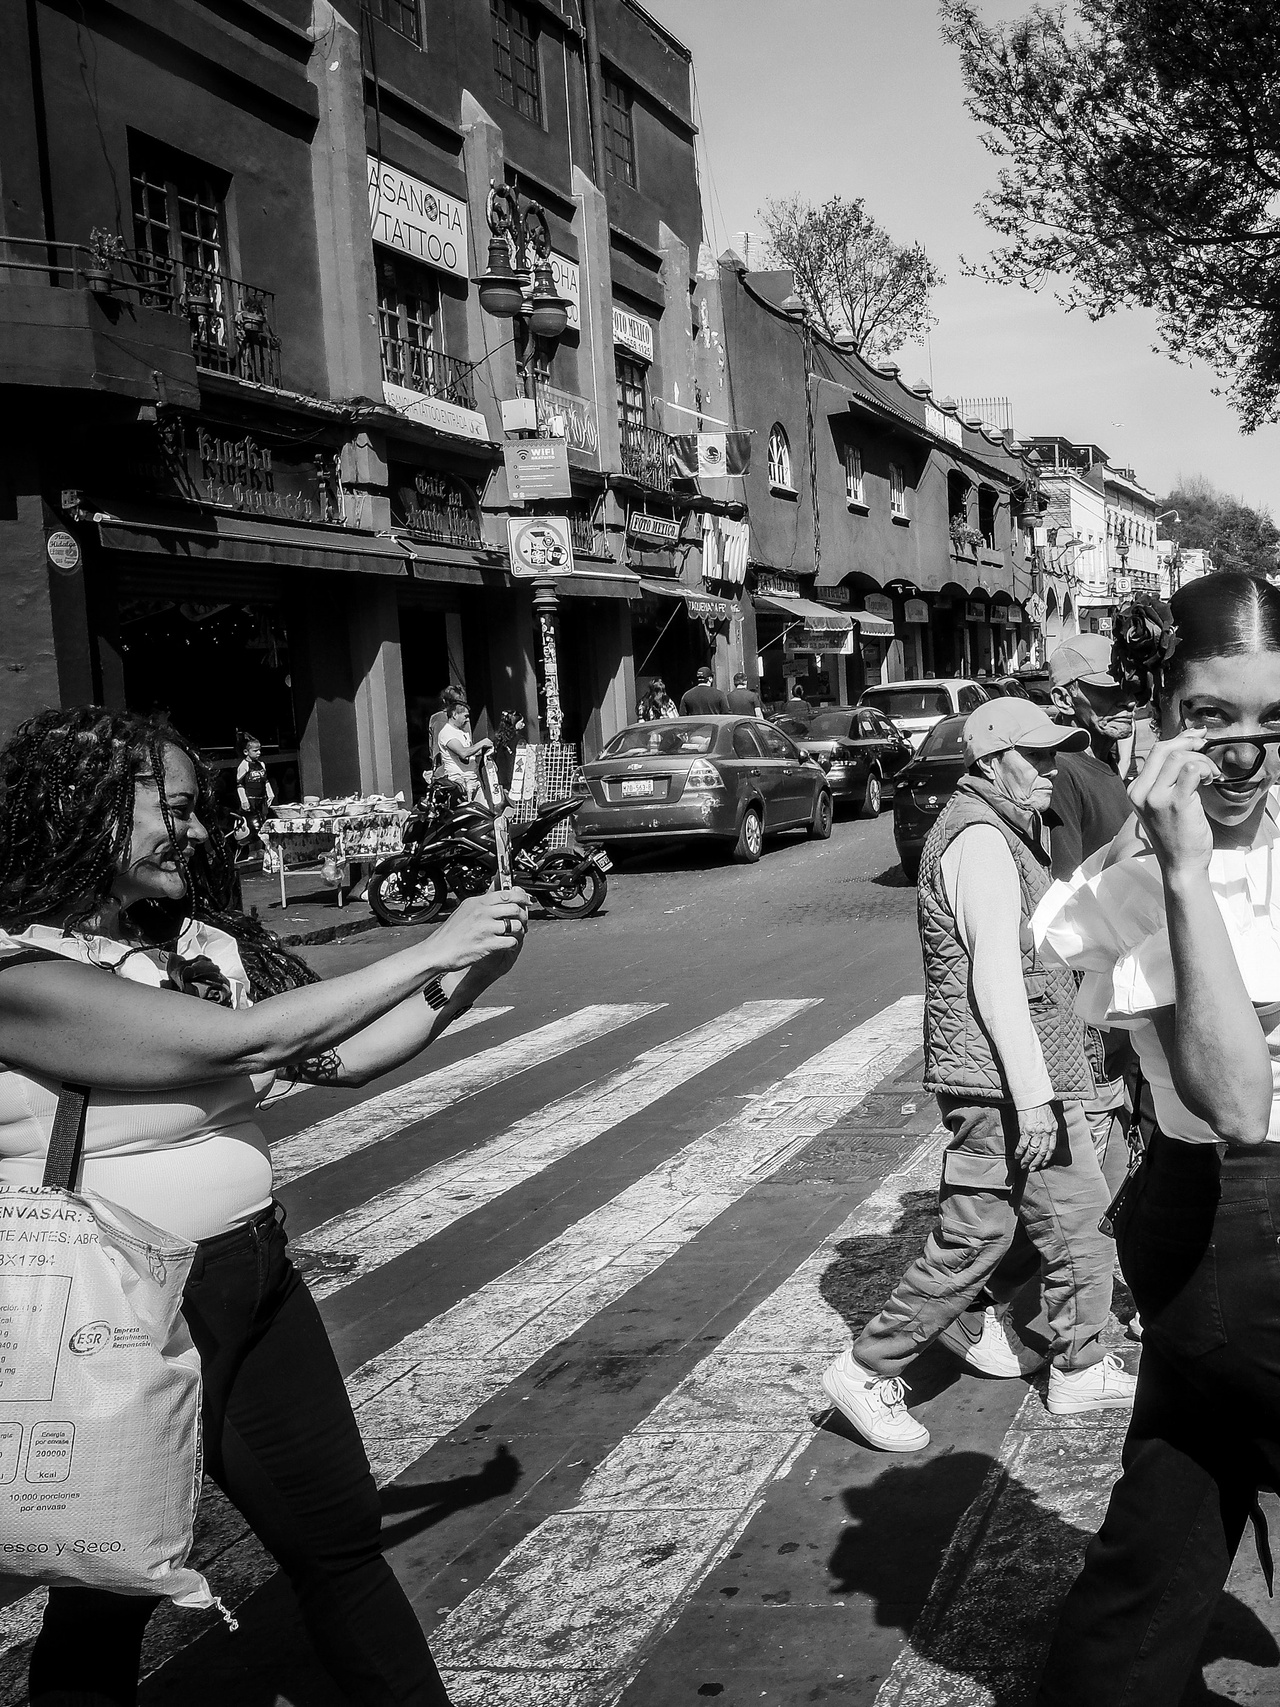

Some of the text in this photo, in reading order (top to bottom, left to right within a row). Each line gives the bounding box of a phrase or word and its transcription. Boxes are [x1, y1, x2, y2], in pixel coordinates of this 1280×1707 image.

[378, 210, 458, 270] TATTOO
[613, 310, 627, 335] OTO
[634, 516, 676, 538] FOTO MEXICO
[0, 1206, 83, 1223] NVASAR:
[18, 1230, 71, 1244] ANTES:
[113, 1327, 140, 1335] Empresa
[76, 1333, 102, 1345] ESR
[35, 1450, 67, 1458] 200000
[40, 1492, 81, 1501] porciones
[20, 1503, 67, 1513] por envase
[0, 1540, 127, 1557] resco y Seco.
